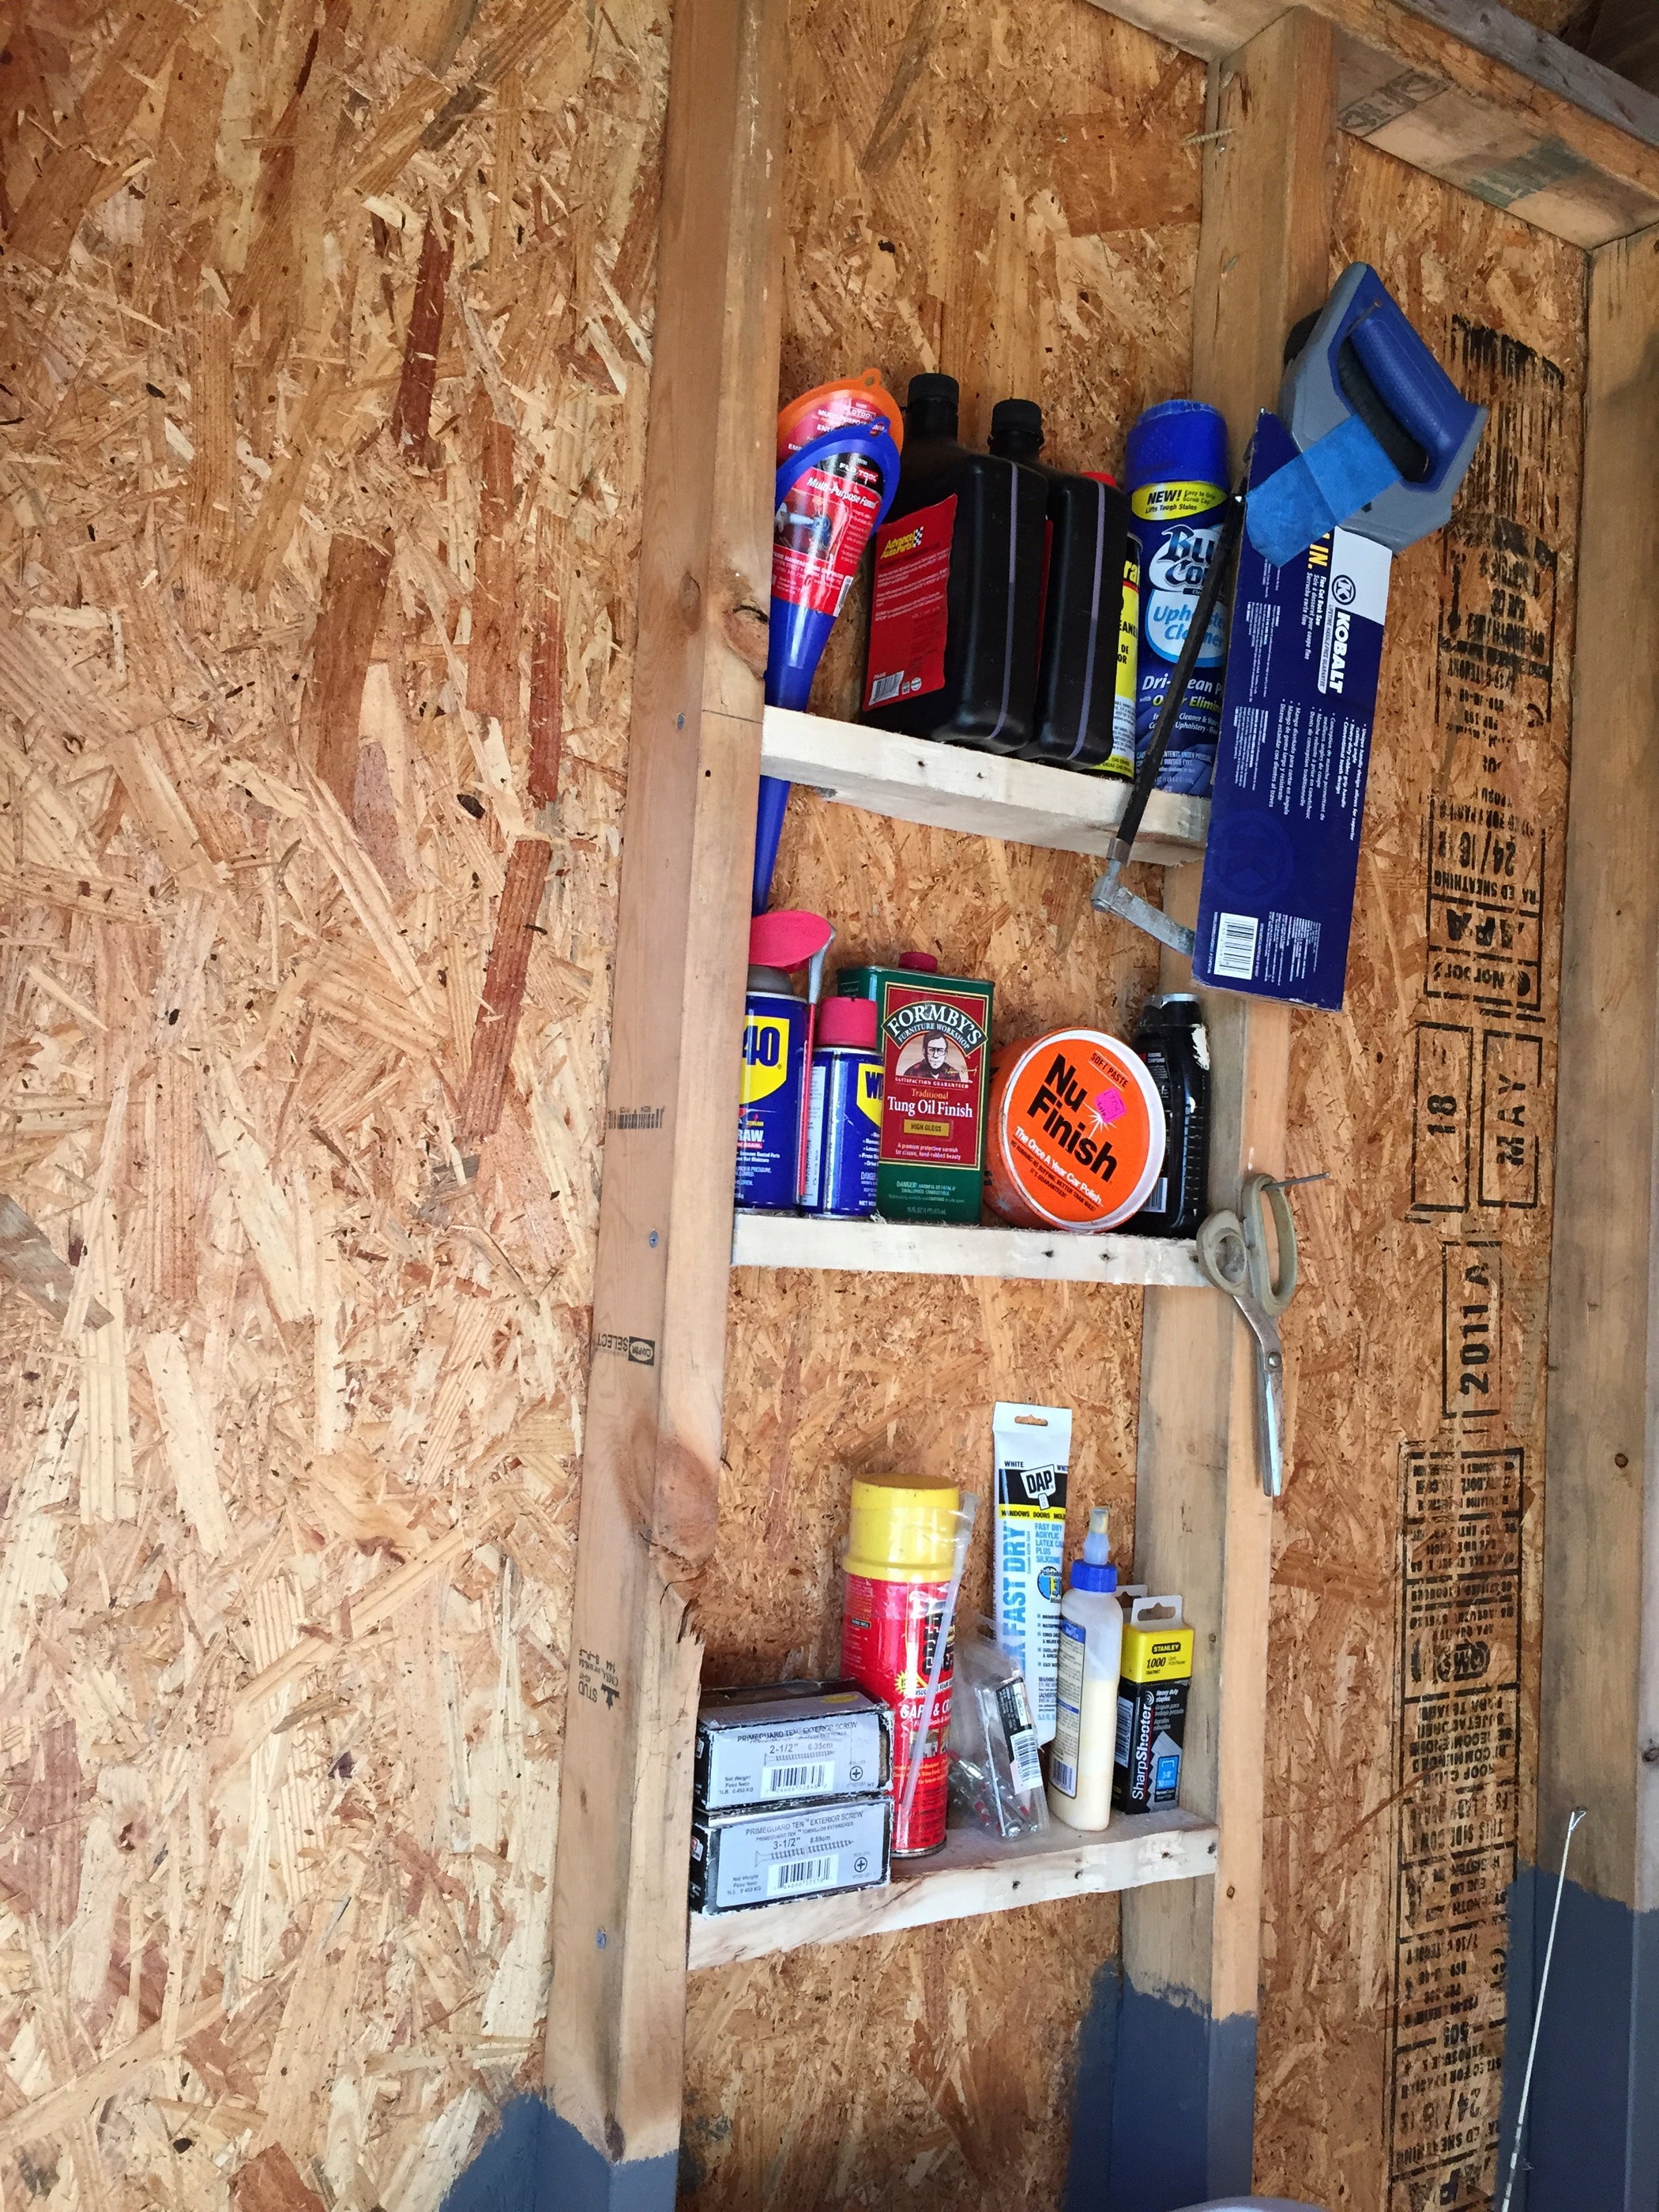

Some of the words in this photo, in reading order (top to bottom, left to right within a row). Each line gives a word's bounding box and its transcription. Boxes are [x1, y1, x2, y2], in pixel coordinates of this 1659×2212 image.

[1146, 505, 1157, 514] Lifts
[1147, 490, 1181, 505] NEW!
[880, 547, 898, 559] Auto
[897, 543, 914, 553] Parts
[886, 532, 914, 550] Advance
[1307, 544, 1329, 569] IN.
[1326, 604, 1334, 626] LIFETIME
[1322, 627, 1331, 658] HASSLE-FREE
[1329, 611, 1351, 694] KOBALT
[1142, 673, 1213, 694] Dri-ean
[1319, 659, 1328, 687] GUARANTEE
[1179, 713, 1202, 723] Cleaner
[1285, 705, 1294, 725] Mango
[1292, 707, 1301, 727] Mango
[1176, 722, 1206, 733] Upholstery
[1327, 717, 1336, 748] Conception
[1340, 721, 1349, 758] Conventional
[1345, 724, 1355, 755] Heavy-duty
[1304, 737, 1312, 767] conception
[1300, 769, 1309, 807] traditionnelle
[1320, 781, 1329, 811] permettant
[1305, 788, 1314, 819] caoutchouc
[1500, 884, 1537, 905] RAED
[887, 1003, 981, 1045] FORMBY'S
[898, 1023, 935, 1043] FURNITURE
[937, 1023, 970, 1049] WORKSHOP
[895, 1077, 931, 1085] SATISFACTION
[1090, 1052, 1109, 1070] SOFT
[1107, 1066, 1129, 1089] PASTE
[912, 1088, 948, 1099] Traditional
[1044, 1053, 1088, 1113] Nu
[887, 1097, 915, 1117] Tung
[918, 1100, 935, 1115] Oil
[937, 1101, 972, 1118] Finish
[1426, 1093, 1458, 1137] 18
[1497, 1072, 1525, 1165] MAY
[1027, 1084, 1118, 1183] Finish
[1015, 1126, 1028, 1144] The
[1028, 1138, 1045, 1160] Once
[1044, 1153, 1051, 1164] A
[1051, 1157, 1067, 1176] Year
[1066, 1172, 1082, 1189] Car
[1029, 1168, 1039, 1178] IT'S
[1056, 1178, 1074, 1194] BETTER
[597, 1333, 629, 1352] SELECT
[1459, 1304, 1490, 1395] 2011
[1026, 1470, 1052, 1494] DAP
[1003, 1525, 1025, 1572] DRY
[1003, 1577, 1025, 1636] FAST
[1153, 1643, 1179, 1653] STANLEY
[578, 1681, 597, 1702] STUD
[901, 1704, 924, 1718] GAP
[933, 1702, 940, 1717] &
[834, 1721, 858, 1730] SCREW
[769, 1743, 798, 1755] 2-1/2"
[1132, 1702, 1152, 1800] SharpShooter
[746, 1823, 790, 1836] PRIMEGUARD
[810, 1815, 840, 1826] EXTERIOR
[841, 1811, 863, 1820] SCREW
[756, 1833, 786, 1841] PRIMEGUARD
[803, 1826, 826, 1834] TORNILLOS
[827, 1822, 854, 1831] EXTERIORES
[773, 1838, 801, 1850] 3-1/2"
[810, 1835, 830, 1844] 8.89cm
